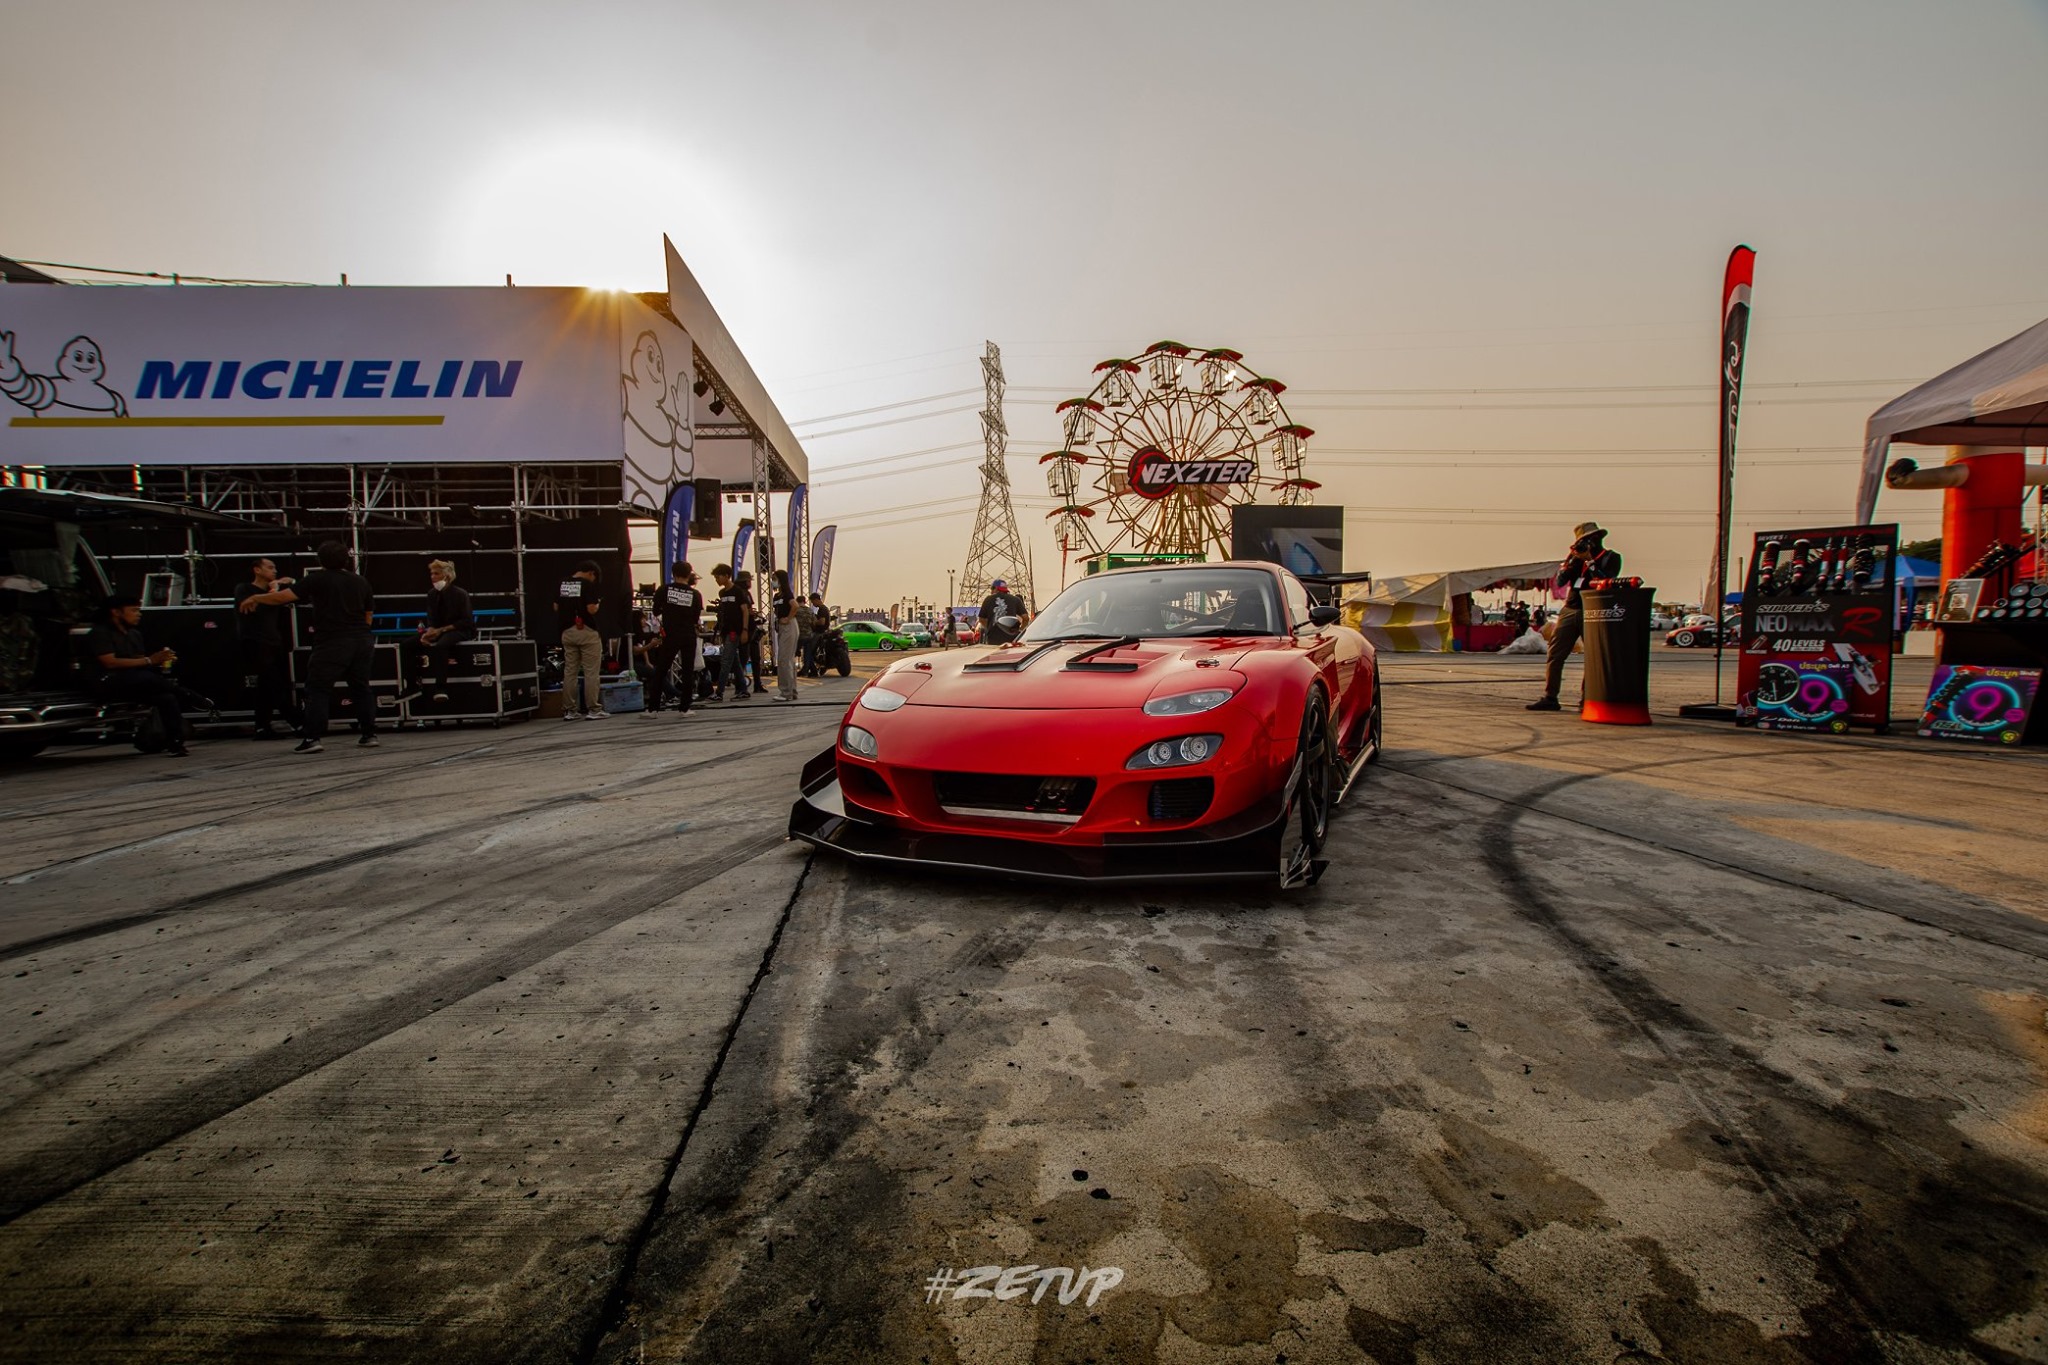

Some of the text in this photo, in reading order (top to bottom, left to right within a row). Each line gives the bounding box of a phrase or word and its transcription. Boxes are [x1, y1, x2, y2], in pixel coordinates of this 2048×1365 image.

[135, 360, 523, 399] MICHELIN
[1132, 462, 1253, 484] NEXZTER
[816, 541, 831, 598] ICHELIN
[1756, 599, 1831, 613] SILVER'S
[1838, 606, 1883, 638] R
[1772, 638, 1792, 652] 40
[1792, 639, 1826, 647] LEVELS
[1800, 679, 1830, 712] 9
[1968, 680, 2004, 713] 9
